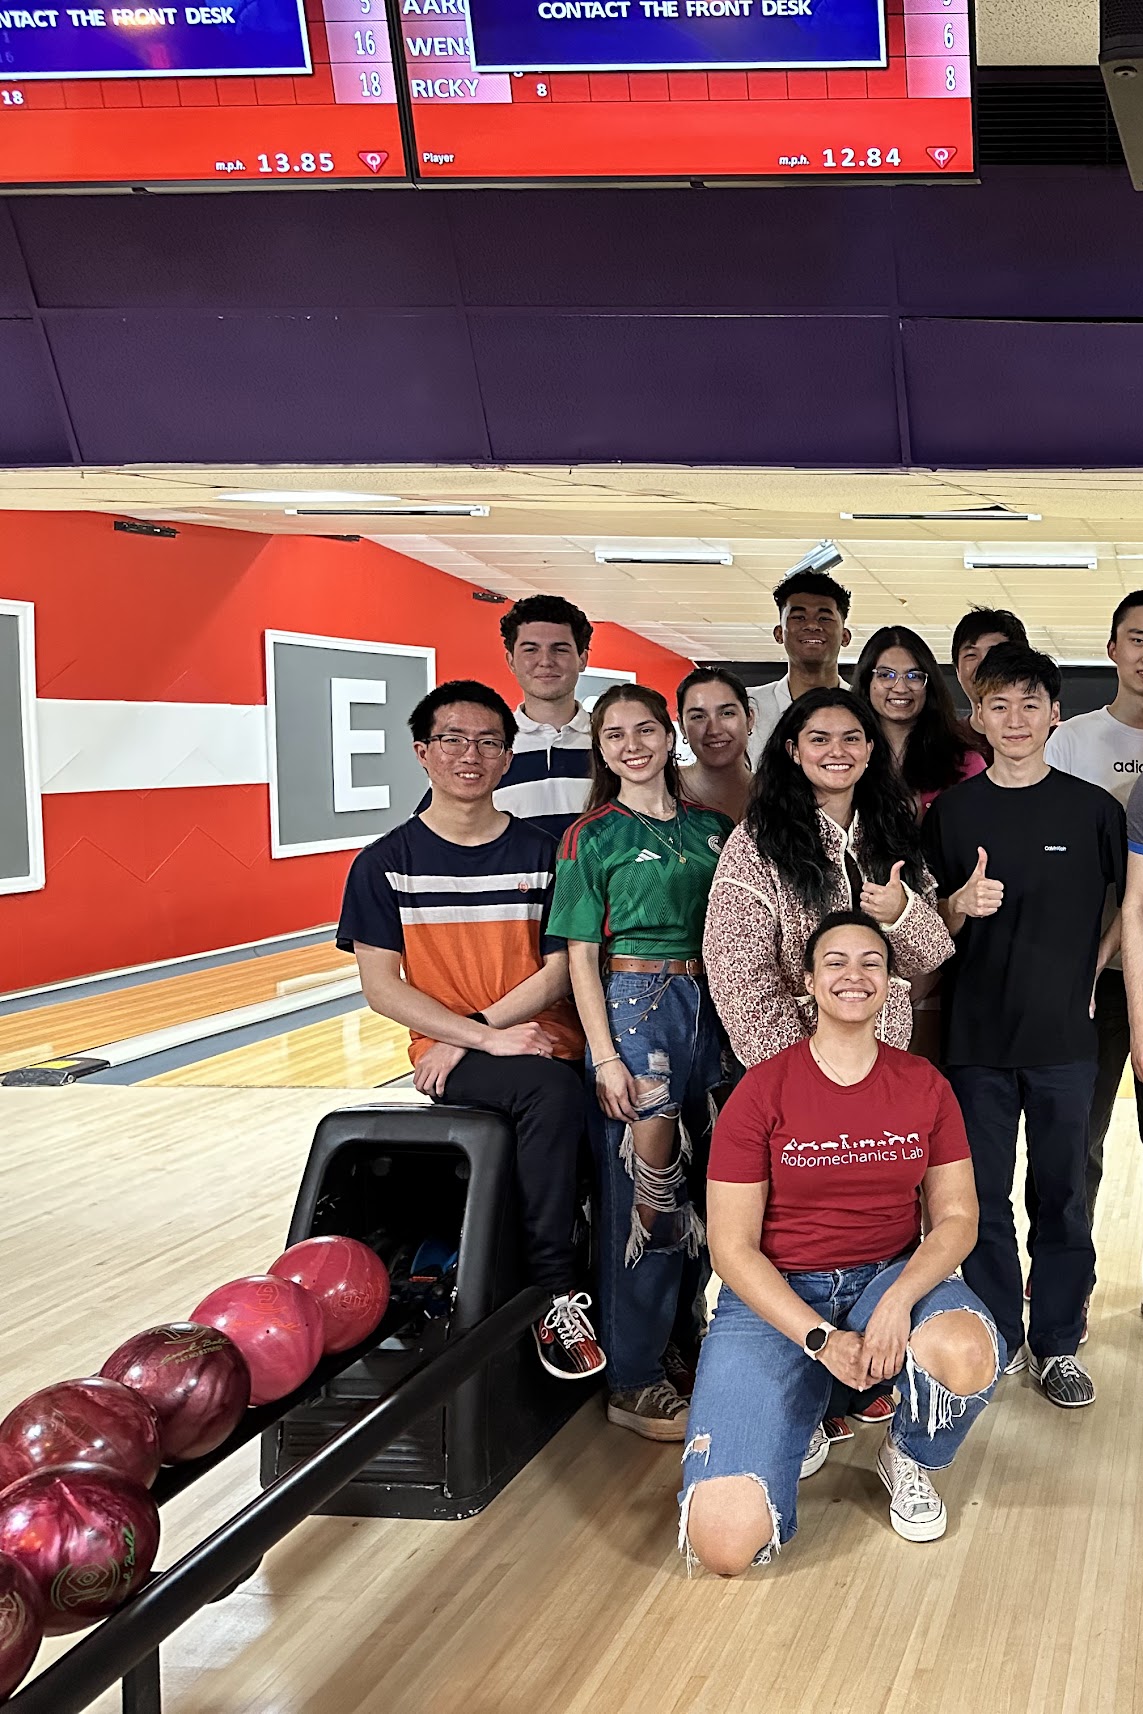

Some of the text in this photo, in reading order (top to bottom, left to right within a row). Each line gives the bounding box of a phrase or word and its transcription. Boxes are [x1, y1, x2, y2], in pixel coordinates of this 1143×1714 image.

[66, 9, 107, 27] THE
[111, 7, 178, 26] FRONT
[184, 7, 236, 25] DESK
[538, 0, 812, 19] CONTACT THE FRONT DESK
[353, 30, 377, 56] 16
[943, 22, 955, 50] 6
[359, 71, 382, 97] 18
[411, 78, 480, 98] RICKY
[944, 64, 957, 91] 8
[1, 90, 24, 105] 18
[536, 82, 548, 97] 8
[215, 152, 334, 173] m.p.h. 13.85
[422, 152, 455, 165] Player
[779, 147, 902, 168] m.p.h. 12.84
[331, 677, 391, 813] E
[781, 1146, 924, 1168] Robomechanics Lab
